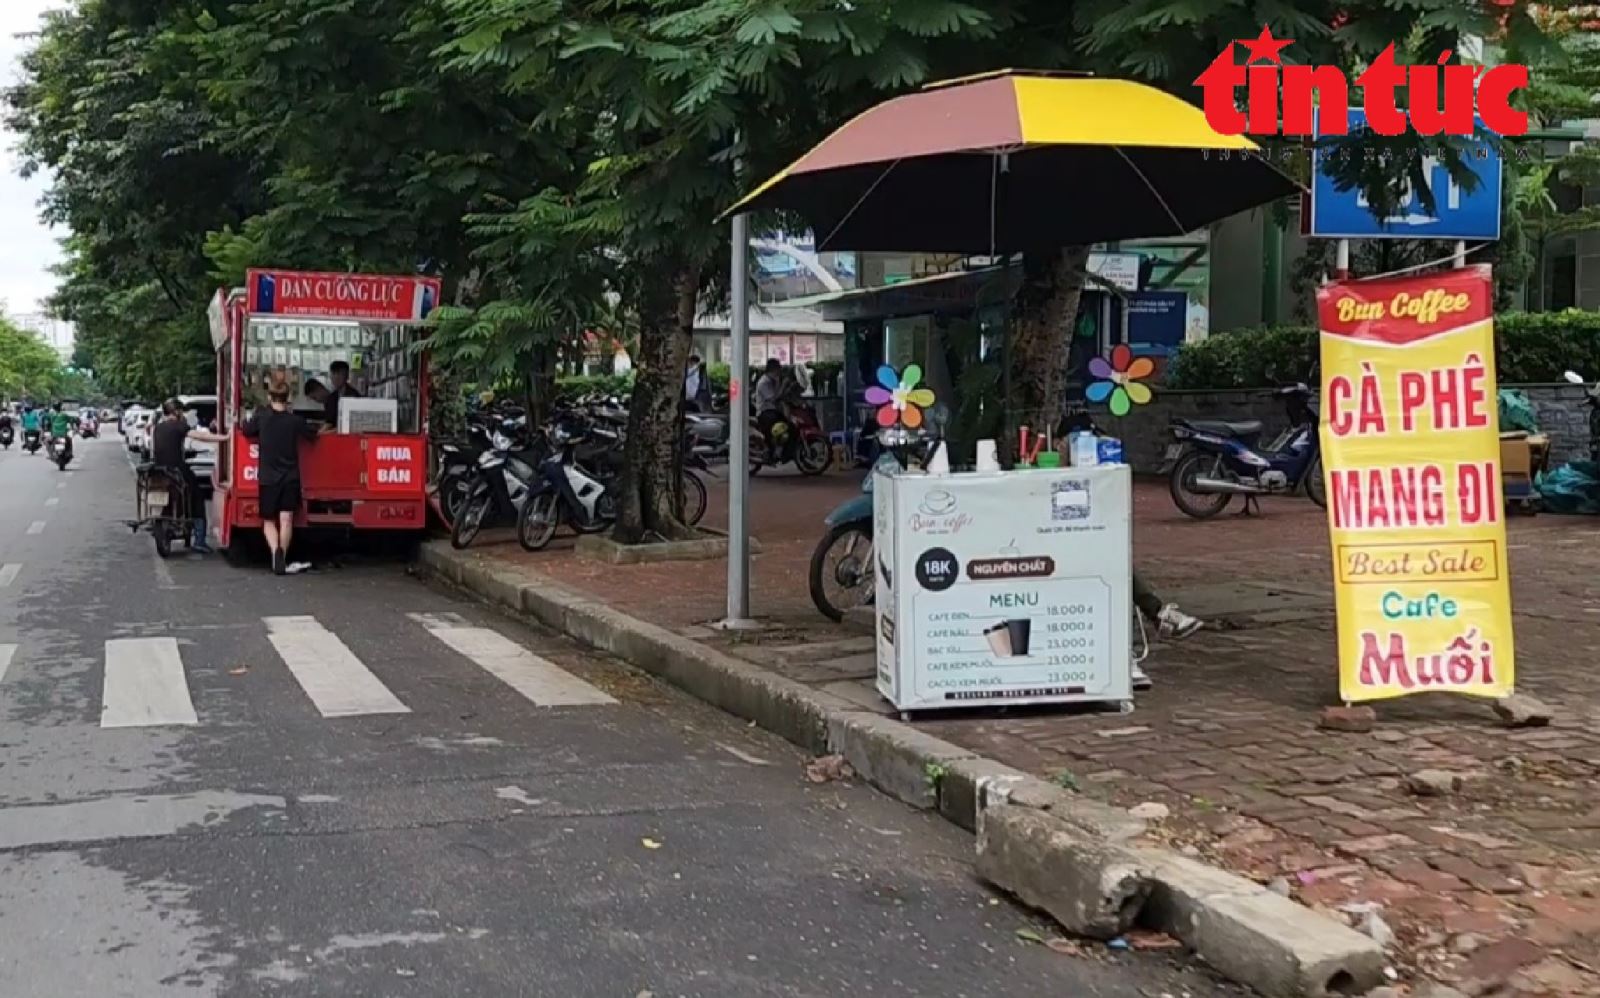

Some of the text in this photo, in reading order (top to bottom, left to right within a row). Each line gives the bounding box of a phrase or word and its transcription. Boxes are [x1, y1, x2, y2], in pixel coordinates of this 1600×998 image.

[1336, 289, 1470, 323] Bun Coffee
[1328, 354, 1487, 437] CÀ PHÊ
[376, 446, 411, 460] MUA
[377, 466, 411, 483] BÁN
[1330, 463, 1496, 528] MANG ĐI
[924, 560, 951, 576] 18K
[973, 559, 1018, 575] NGUYÊN
[1348, 549, 1487, 576] Best Sale
[989, 592, 1039, 608] MENU
[1382, 591, 1458, 618] Cafe
[1046, 604, 1086, 616] 18.000
[1046, 622, 1086, 632] 18.000
[1359, 629, 1494, 688] Muối
